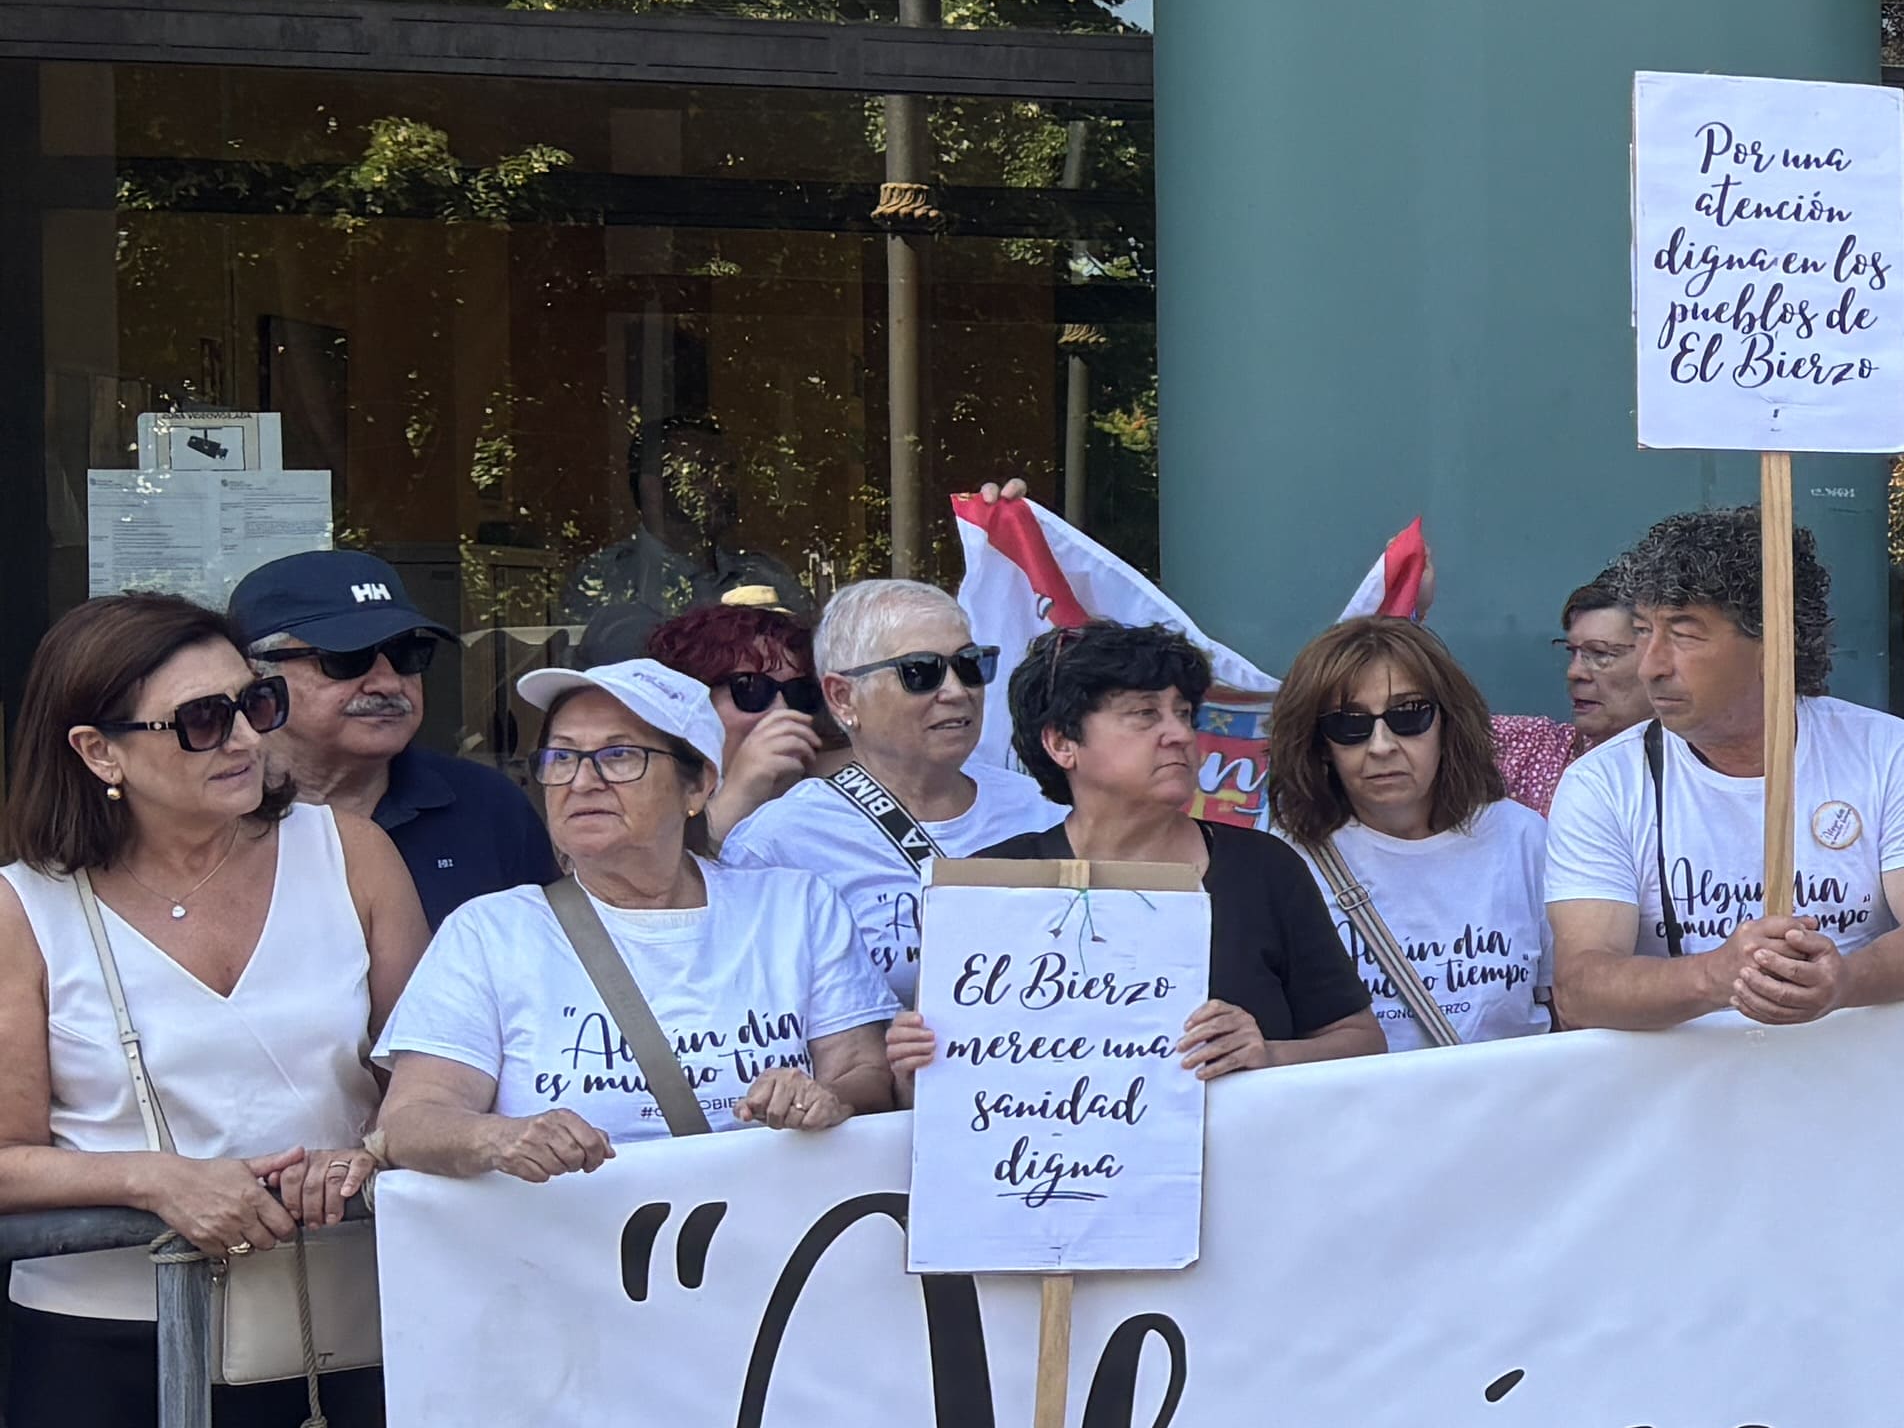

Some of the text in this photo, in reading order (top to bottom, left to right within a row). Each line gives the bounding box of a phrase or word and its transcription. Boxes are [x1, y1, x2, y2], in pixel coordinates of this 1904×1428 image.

[1694, 121, 1852, 174] Por una
[1694, 173, 1853, 227] atención
[1653, 226, 1892, 298] digna en los
[1657, 282, 1879, 350] pueblos de
[1670, 331, 1880, 389] El Bierzo
[1453, 922, 1513, 959] día
[953, 951, 1177, 1011] El Bierzo
[737, 1008, 805, 1049] día
[945, 1031, 1181, 1066] merece una
[534, 1071, 571, 1103] es
[970, 1075, 1149, 1132] sanidad
[993, 1135, 1125, 1208] digna
